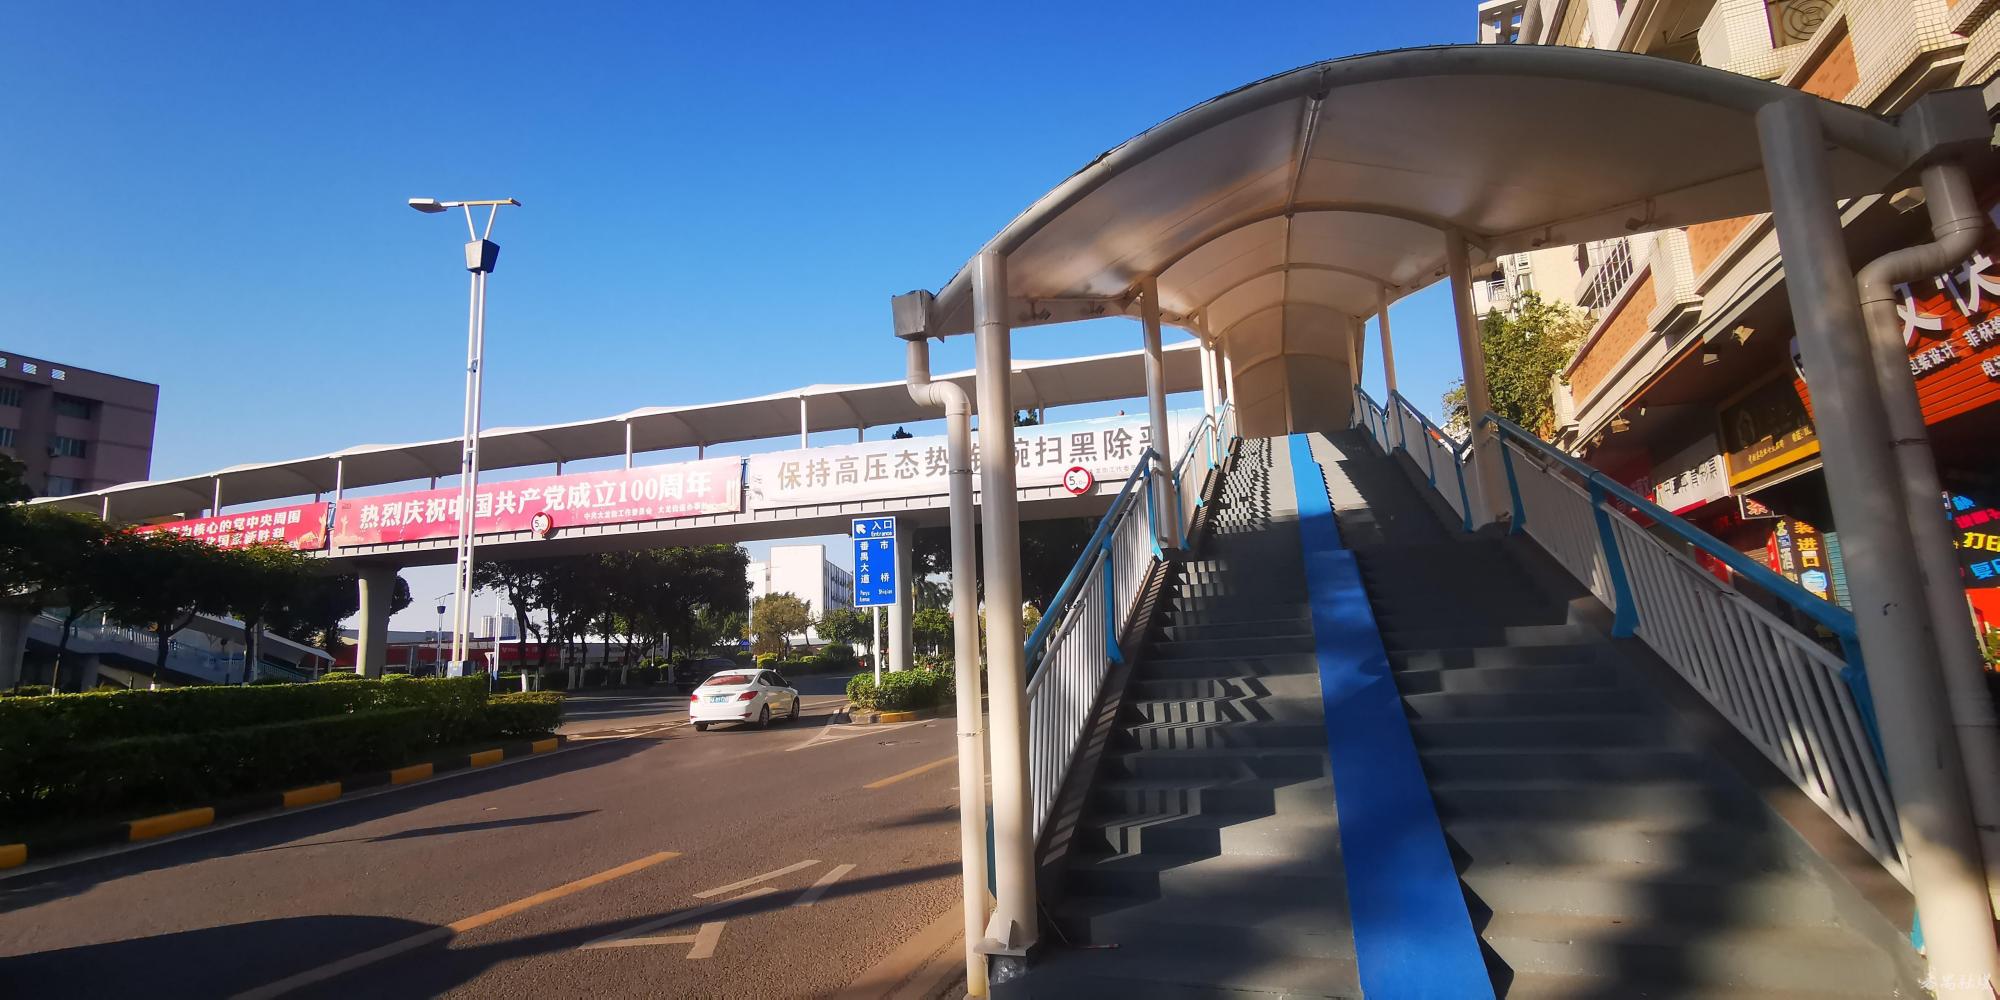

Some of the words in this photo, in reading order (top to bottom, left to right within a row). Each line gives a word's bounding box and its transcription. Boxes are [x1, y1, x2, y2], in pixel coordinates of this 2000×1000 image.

[360, 471, 712, 529] 热烈庆祝中国共产党成立100周年
[870, 530, 893, 538] Entrance
[871, 520, 892, 531] 入口
[860, 541, 870, 584] 番禺大道
[879, 540, 890, 583] 市桥
